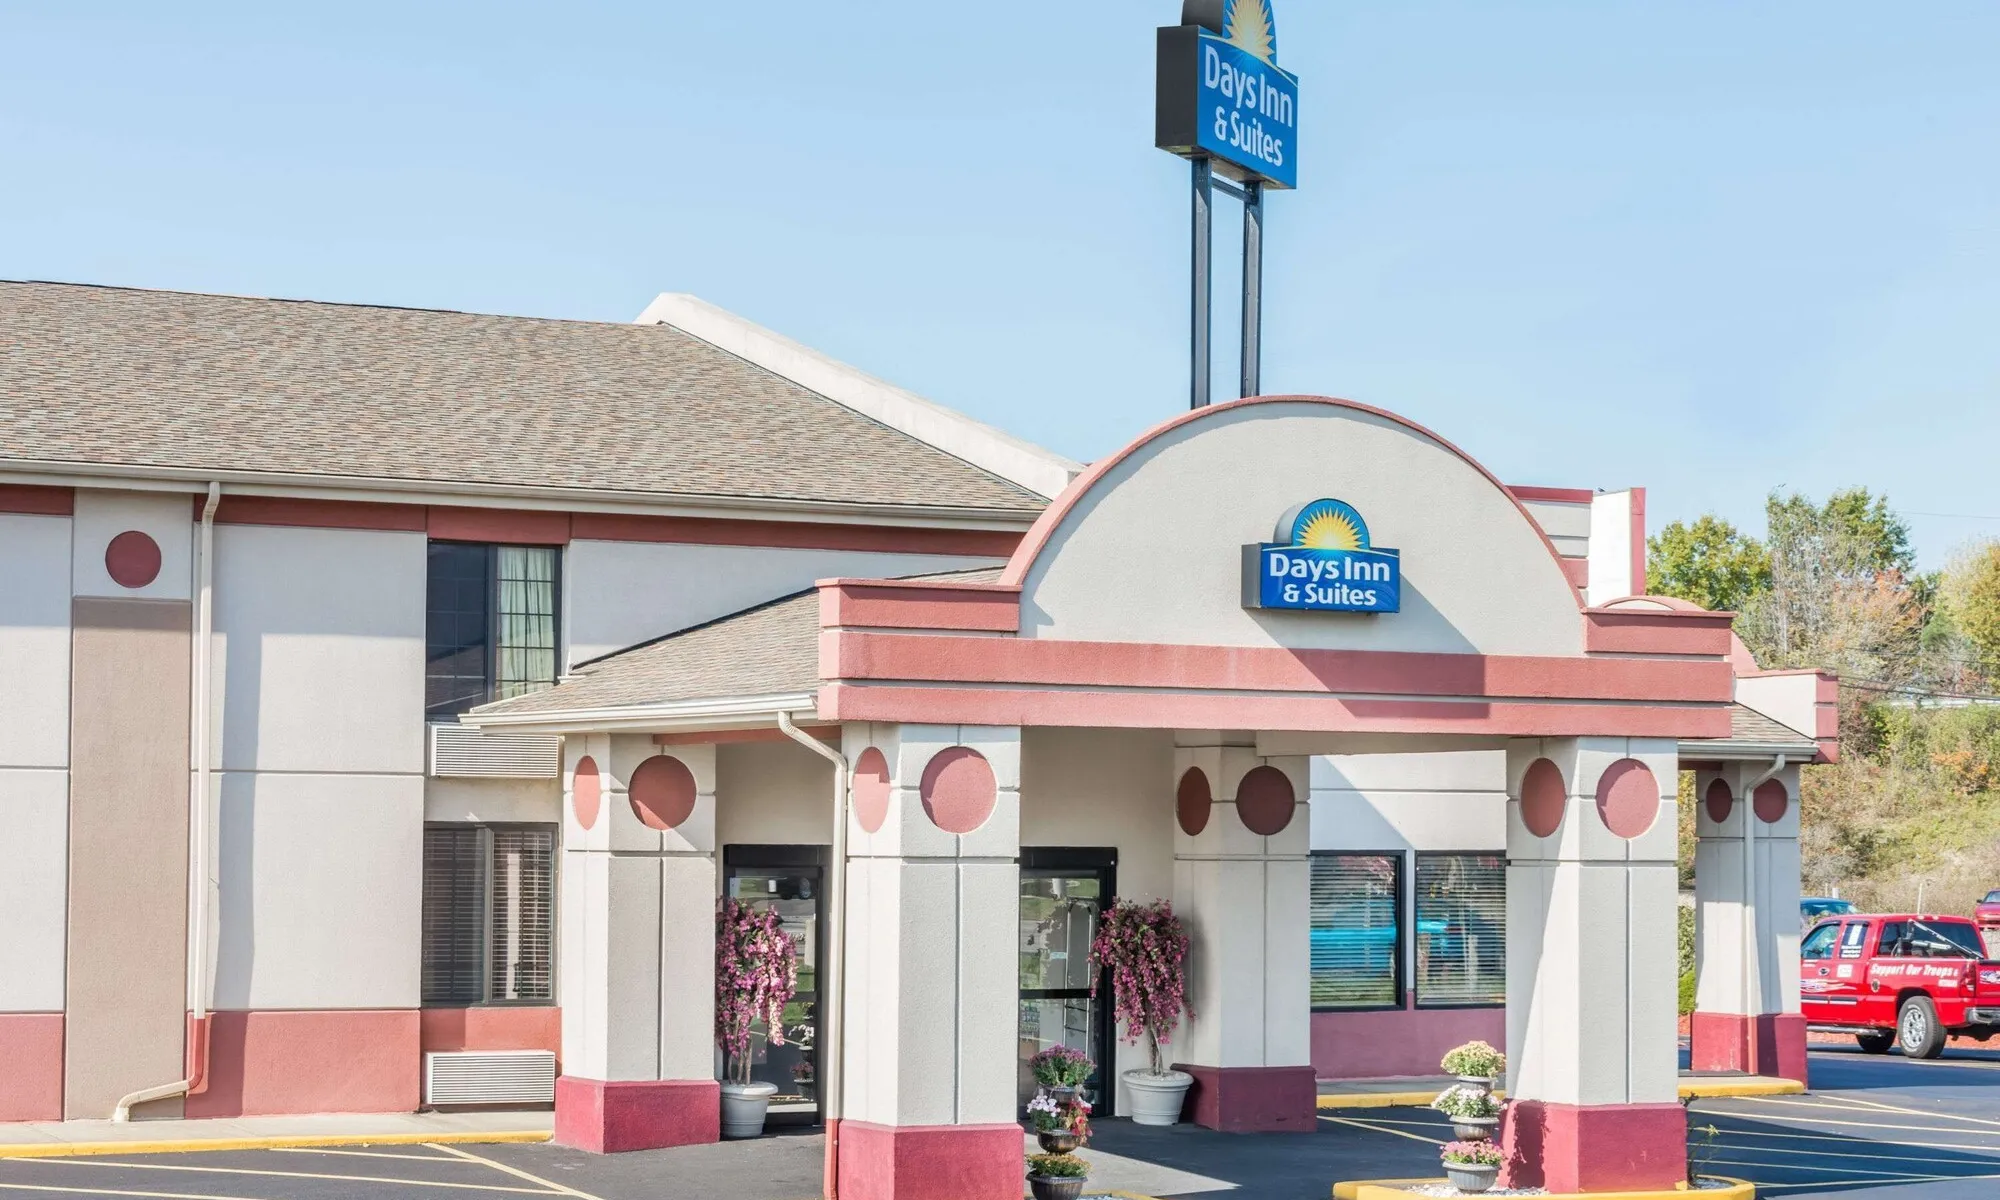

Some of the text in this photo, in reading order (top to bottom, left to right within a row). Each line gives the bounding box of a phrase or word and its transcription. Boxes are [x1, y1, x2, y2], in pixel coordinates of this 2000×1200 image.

[1205, 44, 1293, 128] Days Inn
[1214, 106, 1283, 167] & Suites
[1269, 553, 1390, 582] Days Inn
[1283, 582, 1377, 606] & Suites
[1870, 963, 1905, 977] Support
[1905, 963, 1923, 976] Our
[1923, 964, 1953, 979] Troops
